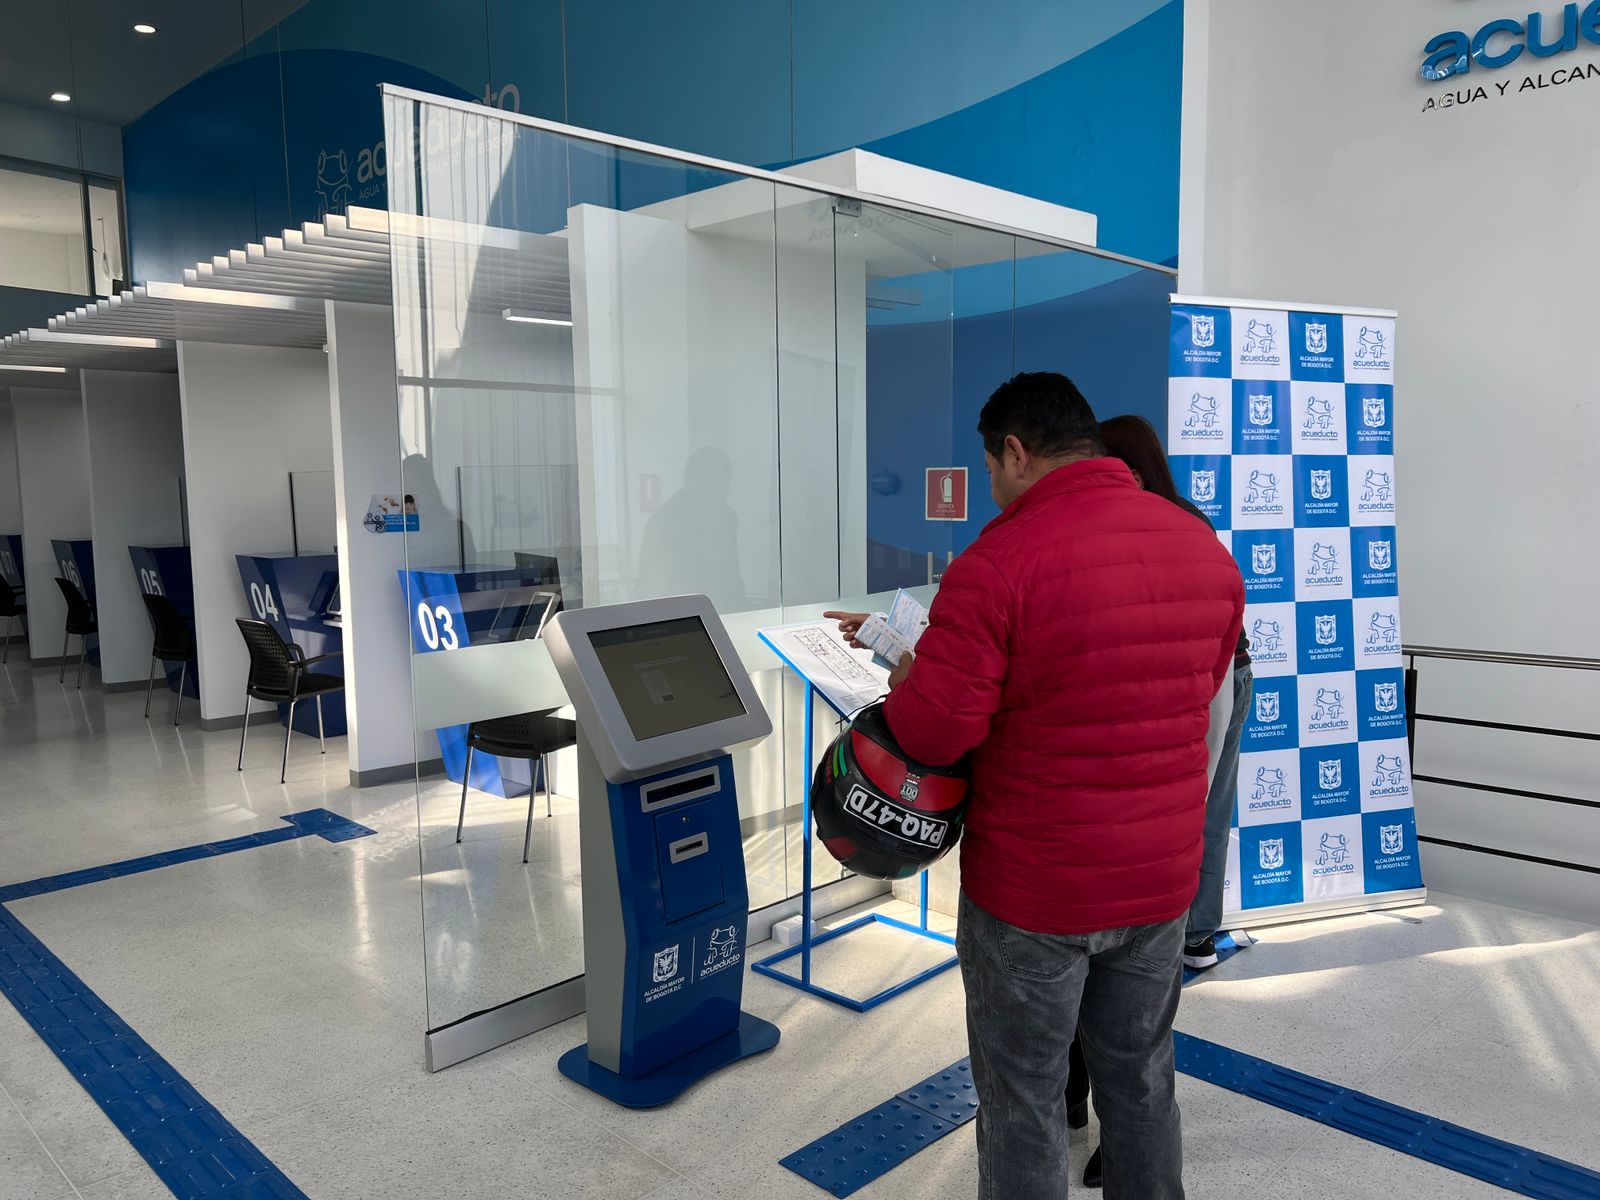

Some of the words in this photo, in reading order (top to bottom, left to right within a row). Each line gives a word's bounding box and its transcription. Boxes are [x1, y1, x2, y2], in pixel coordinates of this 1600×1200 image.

[1422, 87, 1488, 112] AGUA
[1495, 80, 1511, 96] Y
[141, 567, 162, 596] 05
[250, 582, 279, 622] 04
[417, 602, 459, 650] 03
[1251, 652, 1287, 660] cueducto
[1309, 720, 1348, 729] acueducto
[1370, 786, 1408, 795] acueducto
[1249, 799, 1292, 809] acueducto
[850, 790, 945, 844] PAQ-47D
[1313, 864, 1354, 874] acueducto
[701, 954, 740, 976] acueducto
[668, 976, 684, 988] MAYOR
